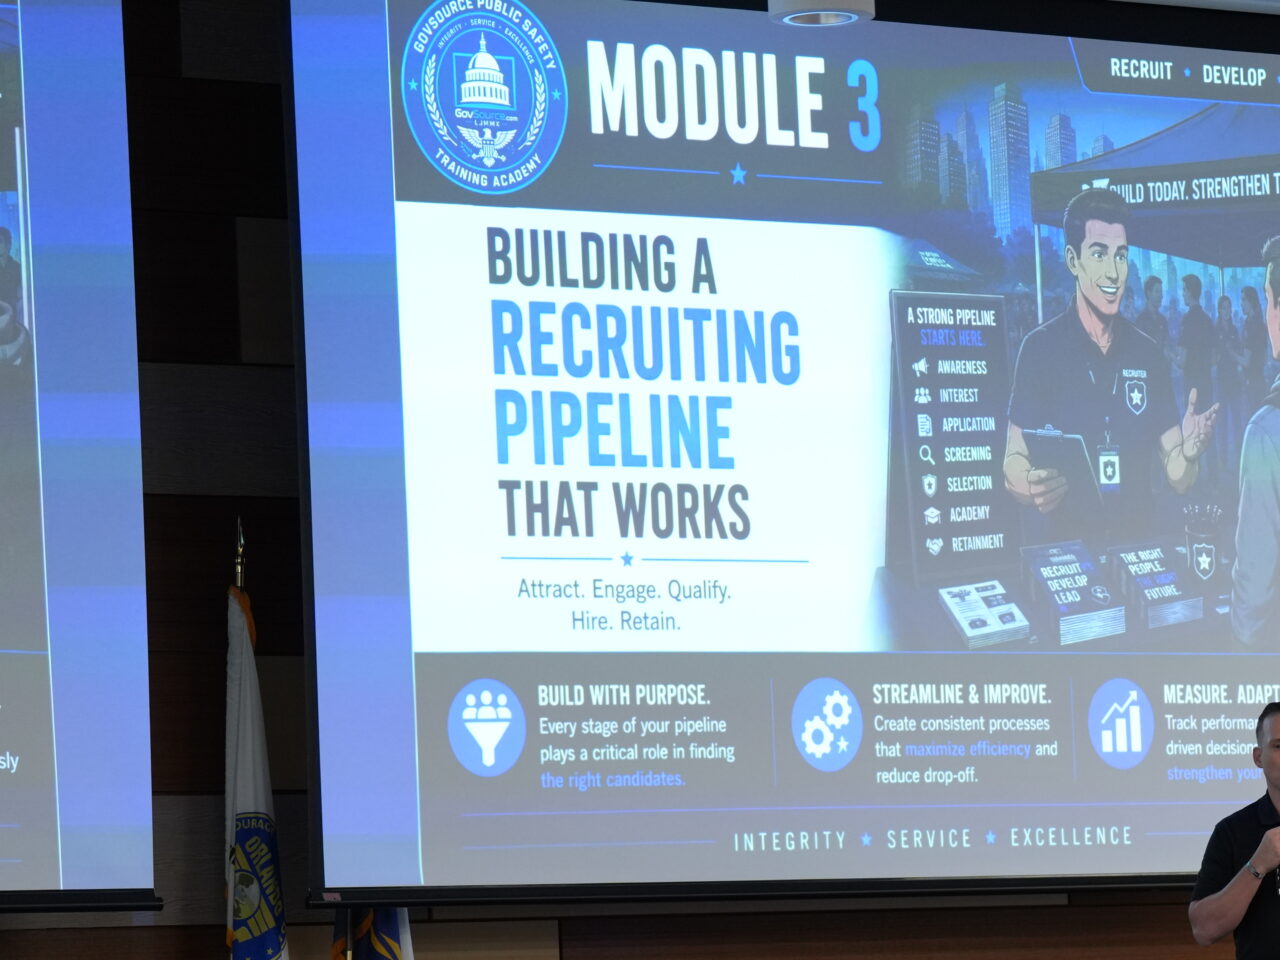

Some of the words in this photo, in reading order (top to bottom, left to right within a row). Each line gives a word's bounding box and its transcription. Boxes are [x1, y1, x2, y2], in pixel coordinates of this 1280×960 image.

[414, 0, 473, 53] GOVSOURCE
[477, 0, 522, 23] PUBLIC
[522, 19, 556, 69] SAFETY
[437, 23, 462, 49] INTEGRITY
[470, 19, 496, 28] SERVICE
[504, 28, 535, 65] EXCELLENCE
[1111, 58, 1173, 81] RECRUIT
[1203, 65, 1267, 88] DEVELOP
[587, 40, 829, 149] MODULE
[846, 59, 882, 152] 3
[435, 148, 488, 187] TRAINING
[493, 153, 541, 187] ACADEMY
[1148, 180, 1189, 203] TODAY.
[1192, 173, 1270, 200] STRENGTHEN
[486, 226, 677, 292] BUILDING
[692, 237, 718, 294] A
[907, 307, 915, 323] A
[917, 308, 954, 325] STRONG
[956, 309, 997, 326] PIPELINE
[490, 299, 801, 386] RECRUITING
[920, 329, 957, 346] STARTS
[959, 330, 988, 347] HERE.
[938, 360, 988, 375] AWARENESS
[940, 388, 979, 403] INTEREST
[494, 388, 735, 470] PIPELINE
[943, 417, 995, 432] APPLICATION
[944, 446, 992, 462] SCREENING
[947, 475, 993, 492] SELECTION
[498, 479, 598, 538] THAT
[612, 483, 751, 540] WORKS
[950, 506, 990, 522] ACADEMY
[952, 534, 1004, 552] RETAINMENT
[1120, 552, 1140, 564] THE
[1138, 548, 1165, 562] RIGHT
[1040, 563, 1082, 579] RECRUIT
[1128, 561, 1166, 576] PEOPLE.
[518, 579, 585, 599] Attract.
[593, 580, 662, 602] Engage.
[668, 579, 732, 603] Qualify.
[1047, 575, 1088, 592] DEVELOP
[1144, 584, 1182, 600] FUTURE.
[1055, 591, 1081, 605] LEAD
[572, 611, 613, 631] Hire.
[620, 611, 681, 631] Retain.
[538, 684, 585, 706] BUILD
[589, 684, 631, 706] WITH
[635, 684, 711, 705] PURPOSE.
[873, 684, 964, 704] STREAMLINE
[968, 684, 979, 704] &
[984, 684, 1052, 704] IMPROVE.
[1163, 684, 1232, 704] MEASURE.
[539, 717, 577, 738] Every
[581, 718, 618, 737] stage
[623, 717, 637, 733] of
[640, 719, 670, 736] your
[675, 716, 727, 736] pipeline
[874, 715, 916, 731] Create
[921, 715, 985, 731] consistent
[989, 717, 1050, 734] processes
[1165, 714, 1198, 730] Track
[540, 744, 576, 765] plays
[580, 748, 588, 761] a
[592, 744, 638, 761] critical
[643, 744, 668, 760] role
[673, 744, 685, 759] in
[689, 743, 735, 763] finding
[875, 741, 901, 757] that
[905, 741, 965, 757] maximize
[969, 740, 1031, 760] efficiency
[1035, 740, 1058, 756] and
[1166, 741, 1202, 755] driven
[540, 772, 564, 788] the
[568, 771, 602, 792] right
[606, 770, 686, 788] candidates.
[877, 768, 920, 783] reduce
[924, 767, 978, 786] drop-off.
[1168, 765, 1232, 784] strengthen
[1236, 768, 1263, 783] your
[734, 831, 846, 852] INTEGRITY
[887, 829, 972, 849] SERVICE
[1010, 826, 1132, 847] EXCELLENCE
[245, 836, 282, 917] ORLANDO
